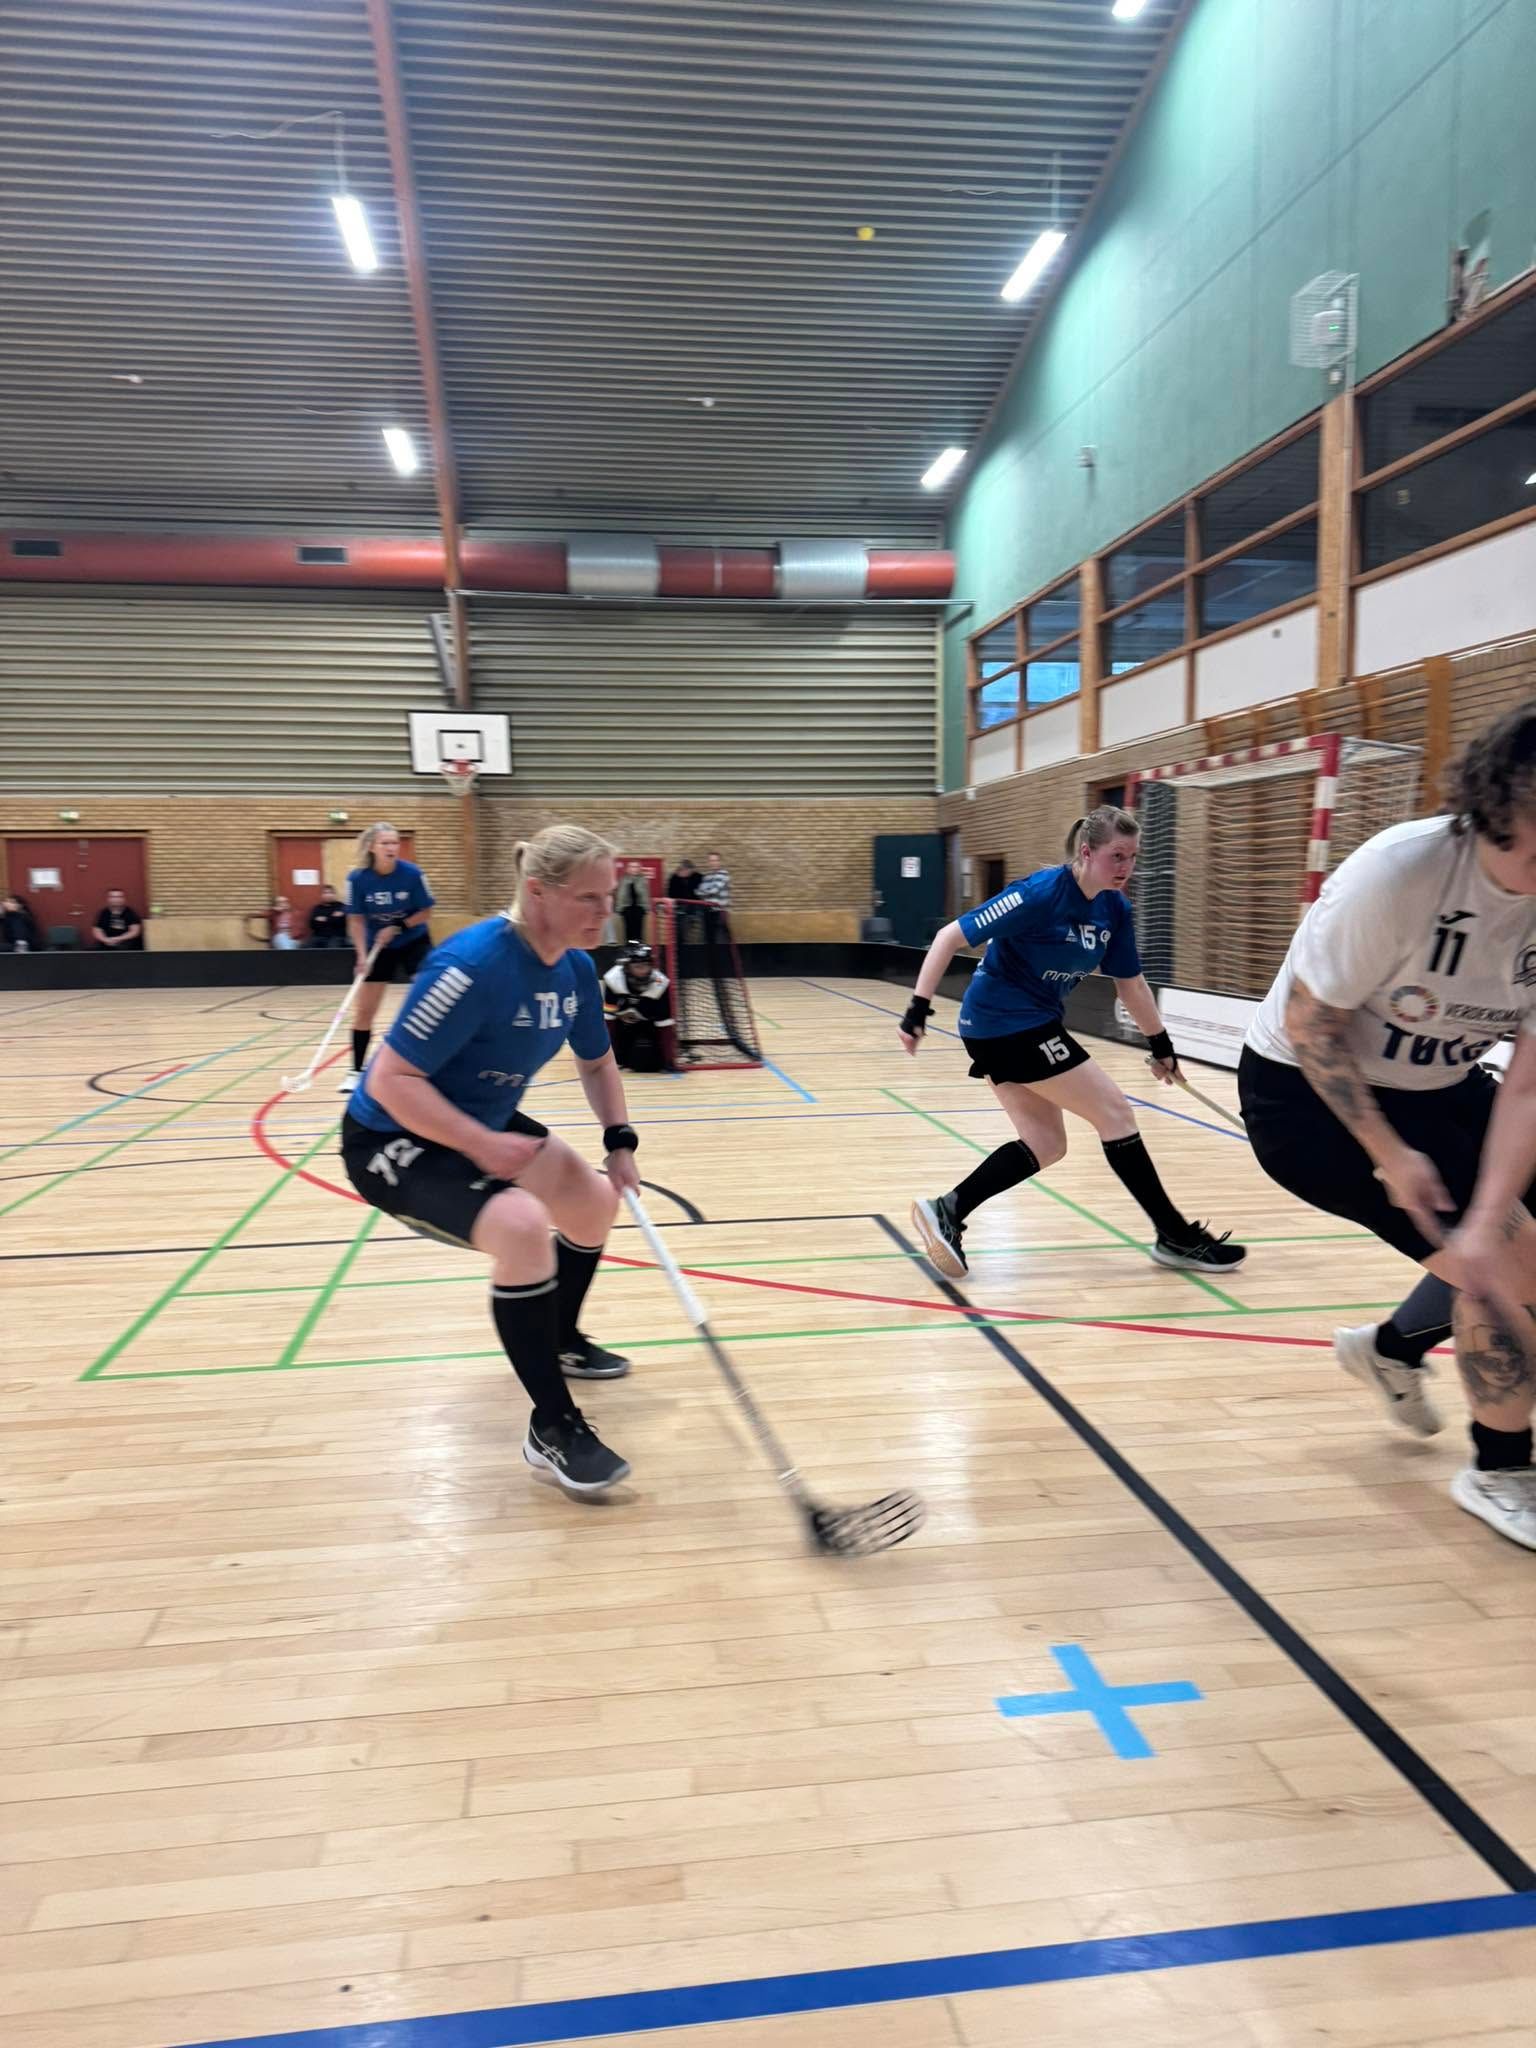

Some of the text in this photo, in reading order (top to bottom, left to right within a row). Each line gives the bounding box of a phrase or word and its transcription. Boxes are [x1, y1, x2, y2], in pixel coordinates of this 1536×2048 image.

[1079, 924, 1097, 950] 15
[1427, 926, 1470, 977] 11
[534, 991, 563, 1030] 72
[1038, 1035, 1071, 1065] 15
[366, 1138, 425, 1187] 72
